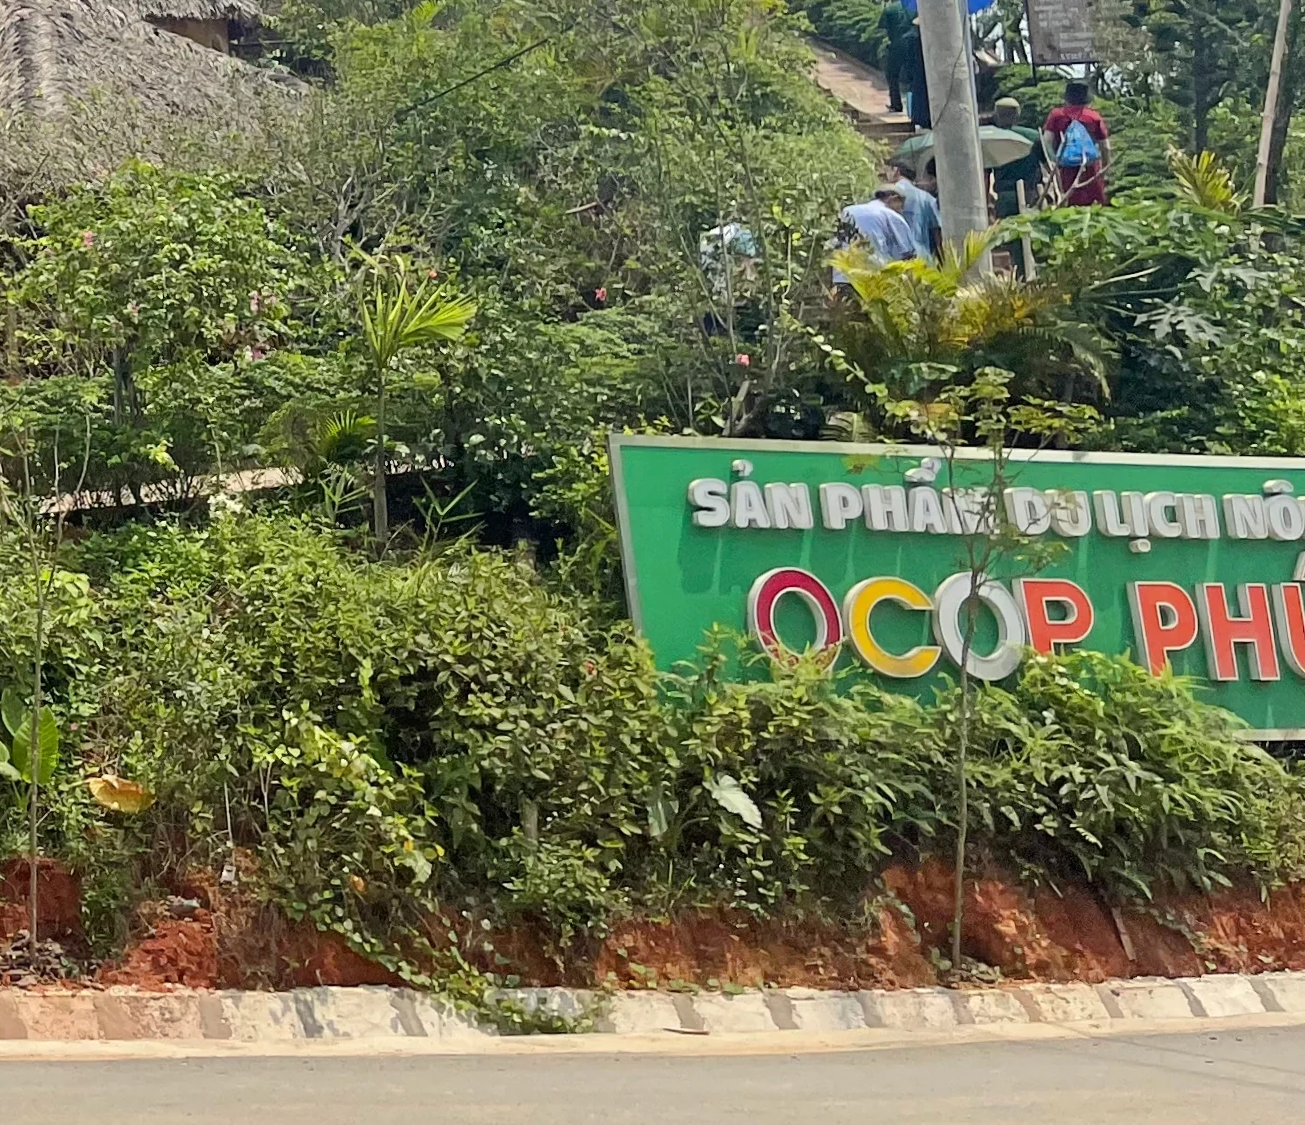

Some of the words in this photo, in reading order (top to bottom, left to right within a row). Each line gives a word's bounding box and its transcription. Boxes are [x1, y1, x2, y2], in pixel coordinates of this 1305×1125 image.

[688, 459, 814, 530] SẢN
[1003, 485, 1091, 538] DU
[1093, 487, 1221, 553] LỊCH
[1222, 479, 1305, 542] NÔ
[747, 566, 1095, 682] OCOP
